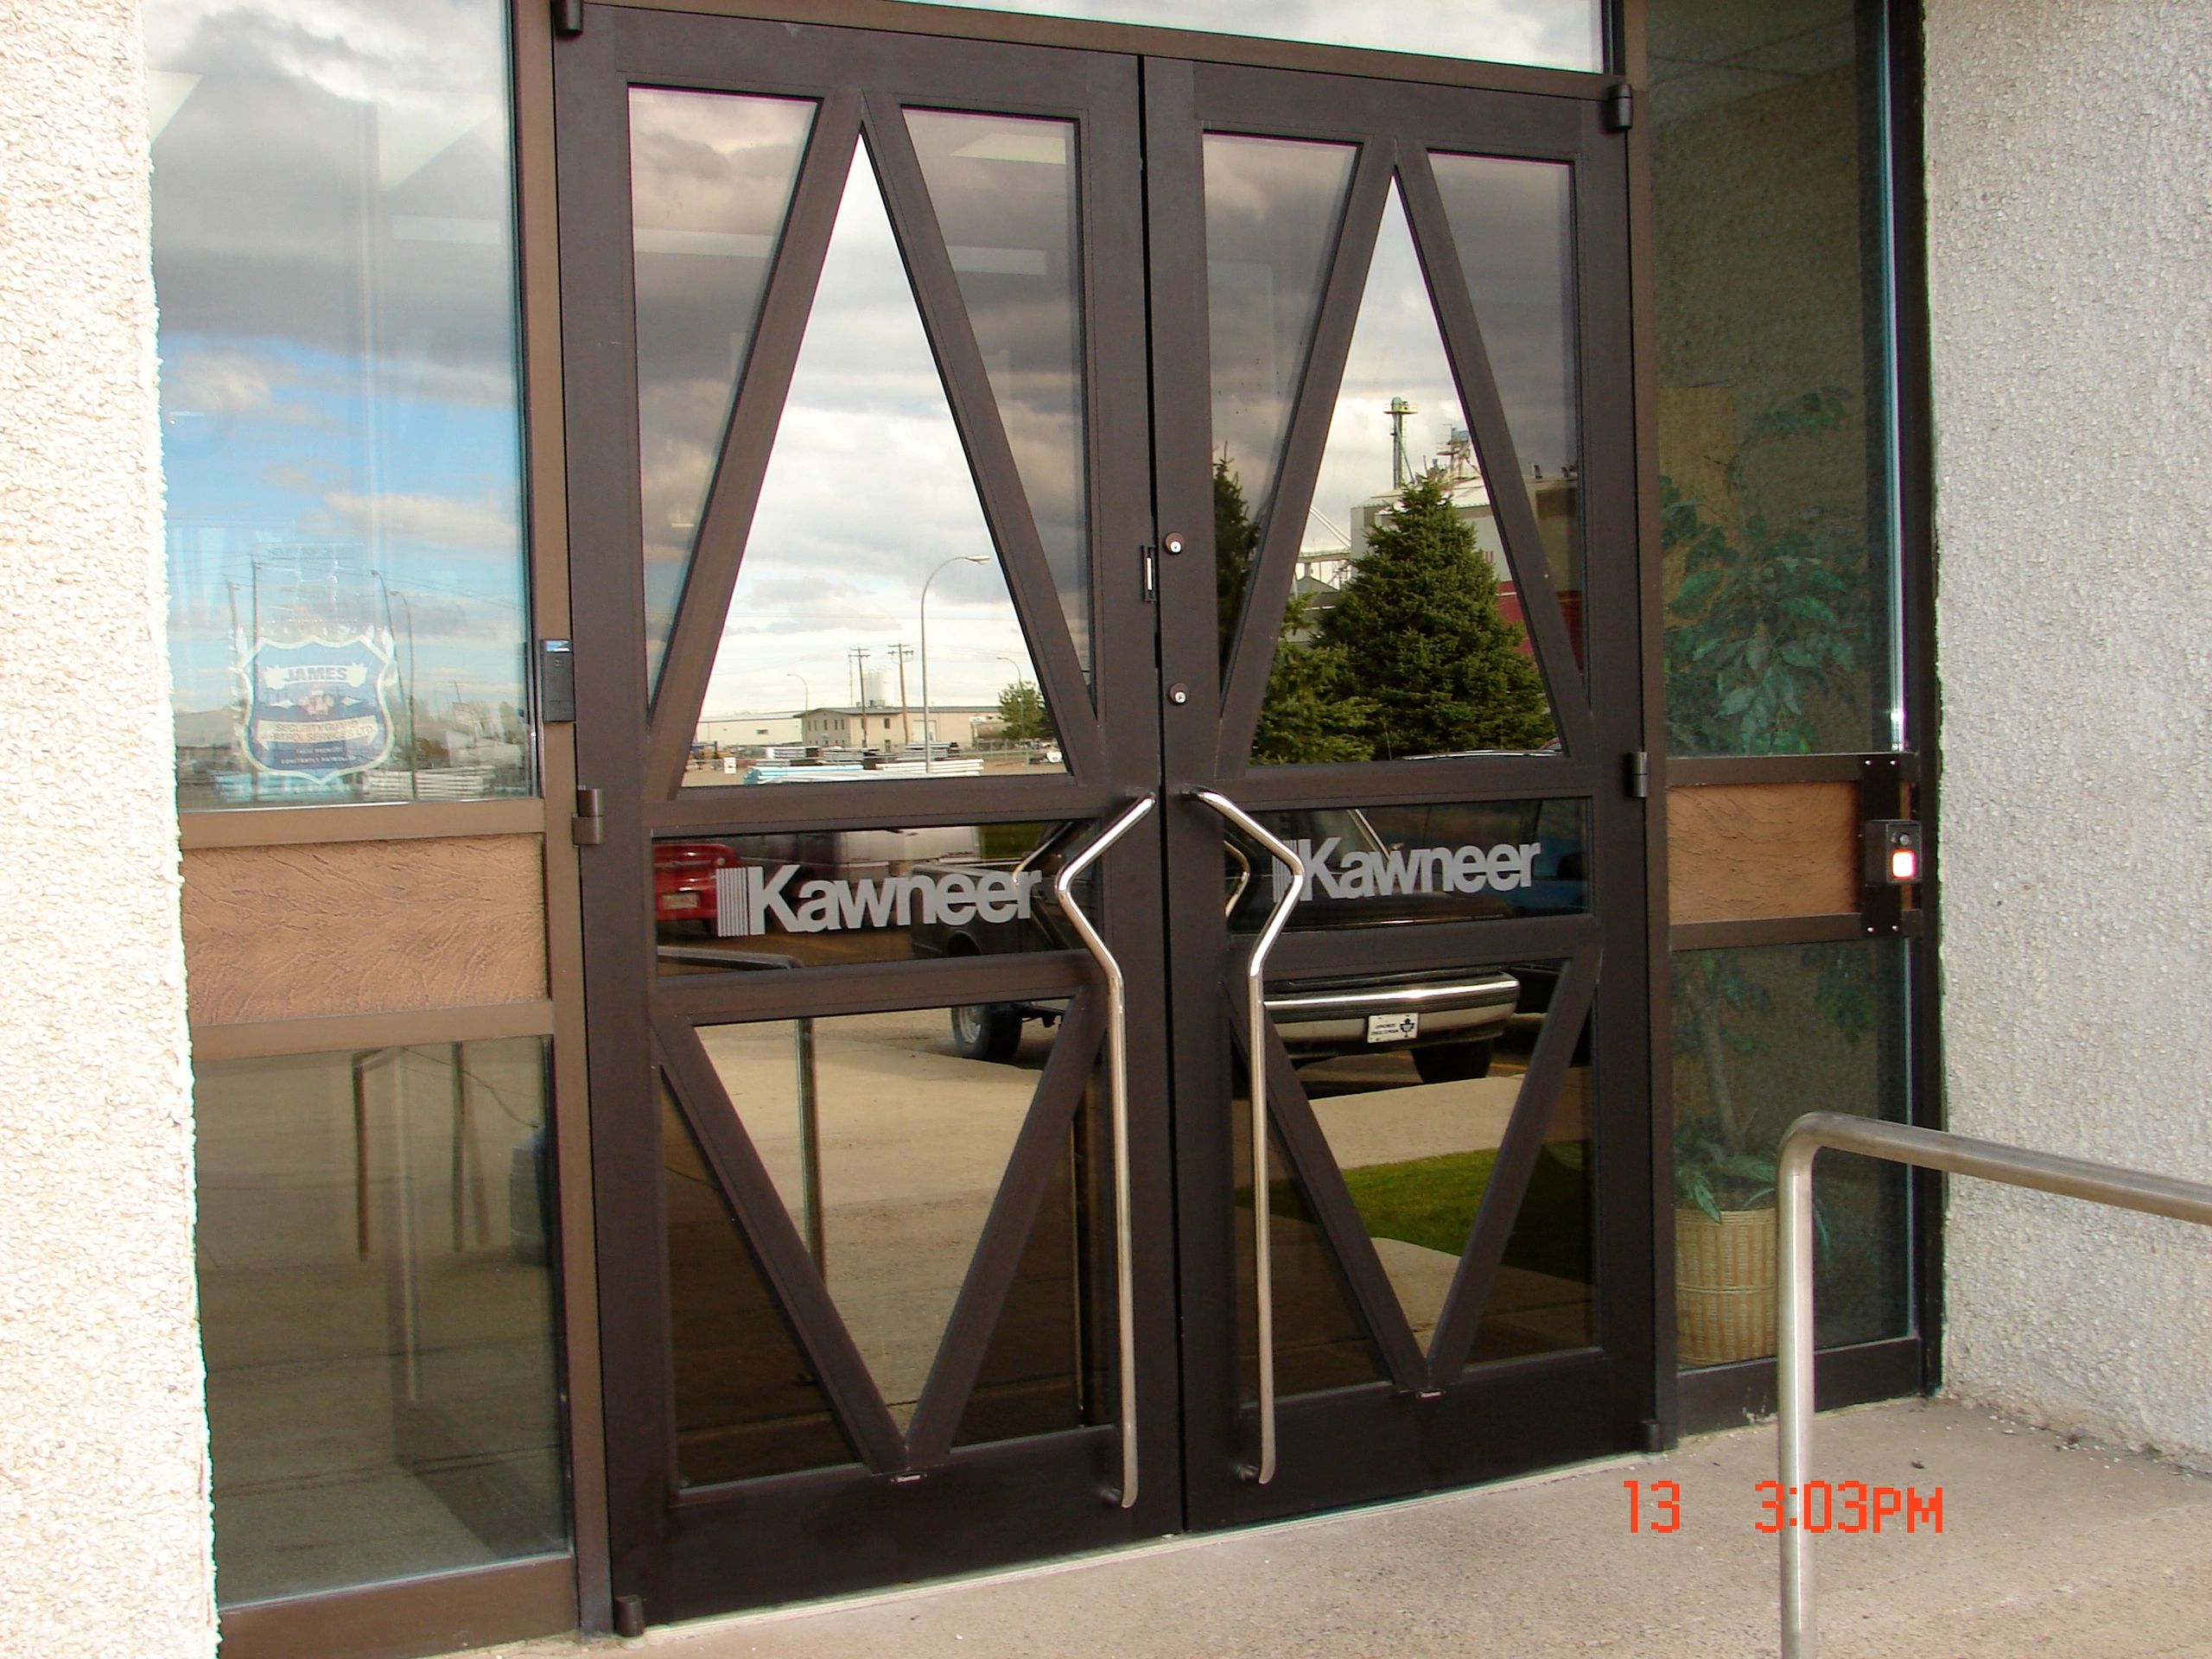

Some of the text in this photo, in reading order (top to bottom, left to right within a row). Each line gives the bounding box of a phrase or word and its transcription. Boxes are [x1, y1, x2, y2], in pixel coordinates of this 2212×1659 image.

[284, 667, 348, 682] JAMES
[276, 720, 359, 733] SECURITY GUARD
[307, 728, 354, 741] SERVICES
[1298, 836, 1541, 902] Kawneer
[747, 863, 1042, 936] Kawneer
